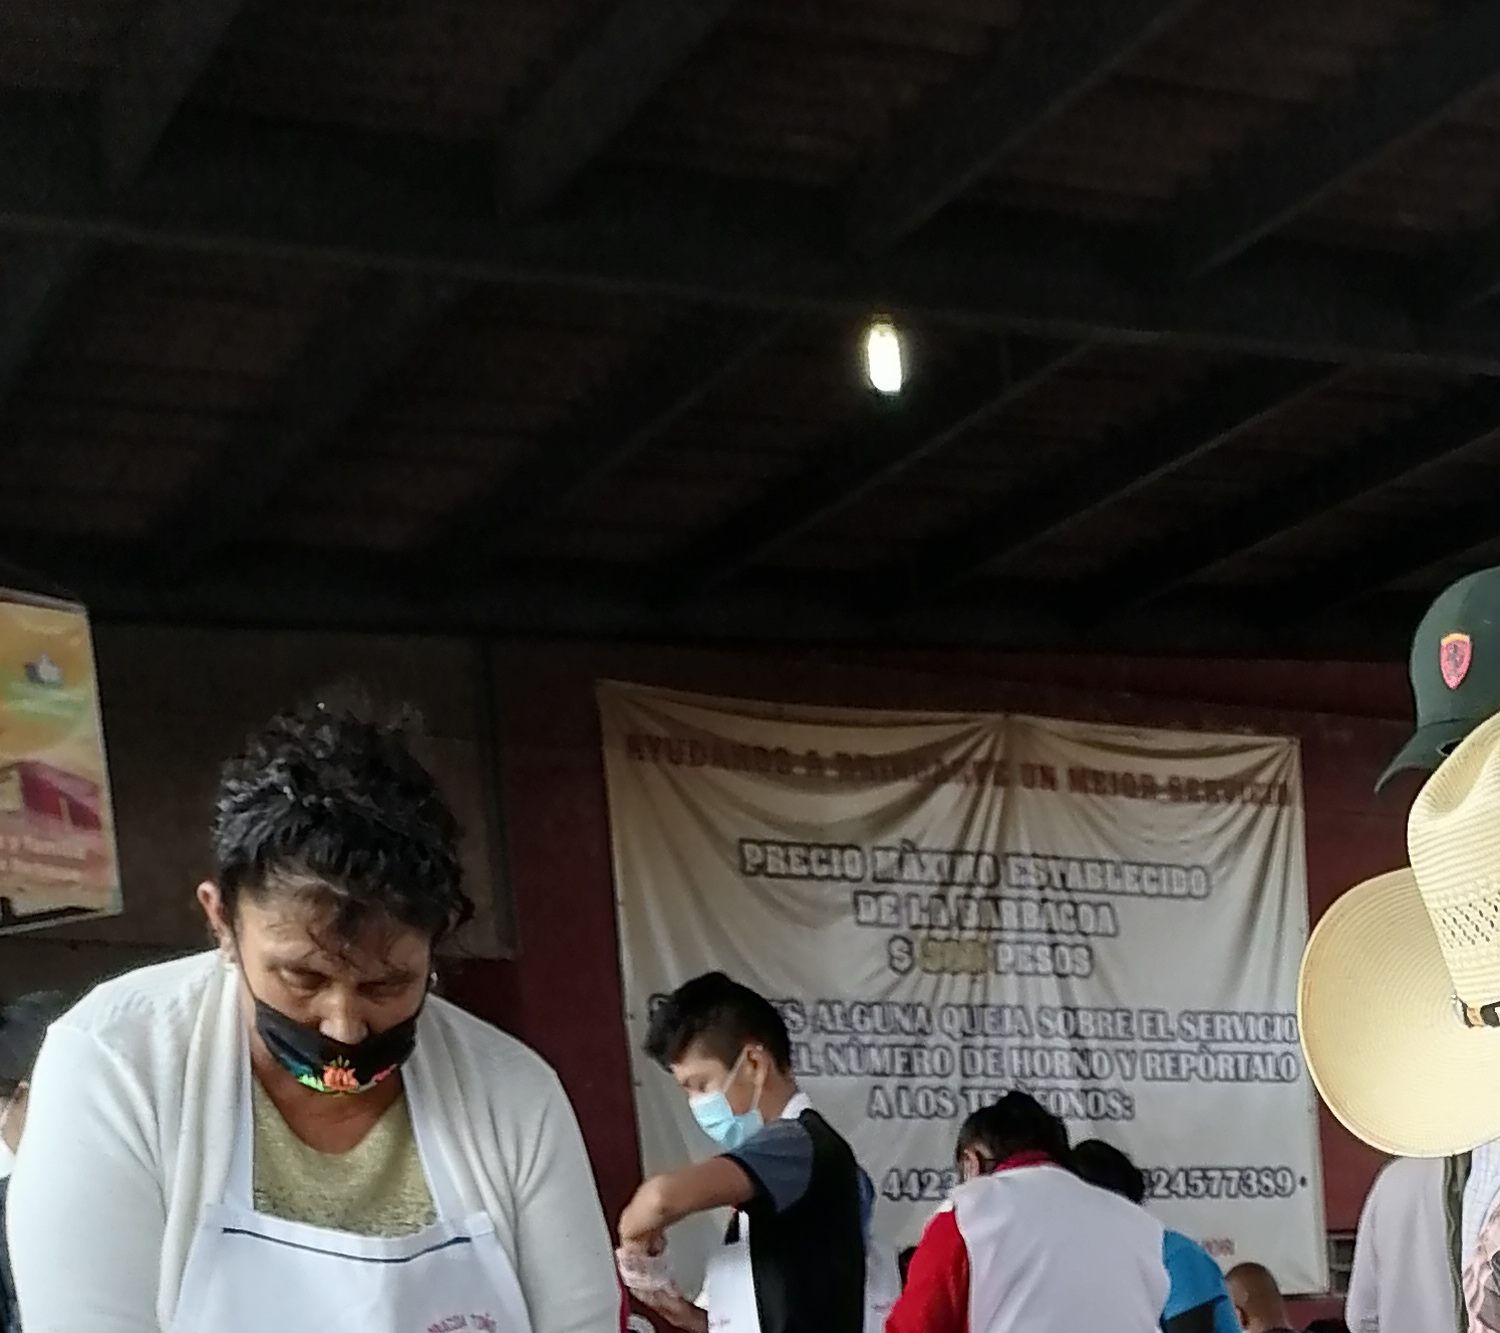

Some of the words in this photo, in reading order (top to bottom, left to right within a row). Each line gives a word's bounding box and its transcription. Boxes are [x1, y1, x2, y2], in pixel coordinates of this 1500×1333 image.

[740, 838, 862, 882] PRECIO
[1005, 852, 1210, 899] ESTABLECIDO
[854, 890, 900, 926] DE
[904, 892, 951, 930] LA
[955, 893, 1118, 937] BARBACOA
[993, 938, 1095, 977] PESOS
[811, 1000, 933, 1035] ALGUNA
[939, 1002, 1032, 1041] QUEJA
[1036, 1006, 1135, 1041] SOBRE
[1137, 1008, 1176, 1043] EL
[1176, 1011, 1300, 1044] SERVICIO
[960, 1044, 1003, 1079] DE
[1008, 1047, 1113, 1081] HORNO
[1113, 1048, 1139, 1081] Y
[867, 1085, 892, 1119] A
[895, 1087, 958, 1119] LOS
[961, 1079, 1135, 1121] TEFONOS:
[1142, 1167, 1297, 1199] 24577389
